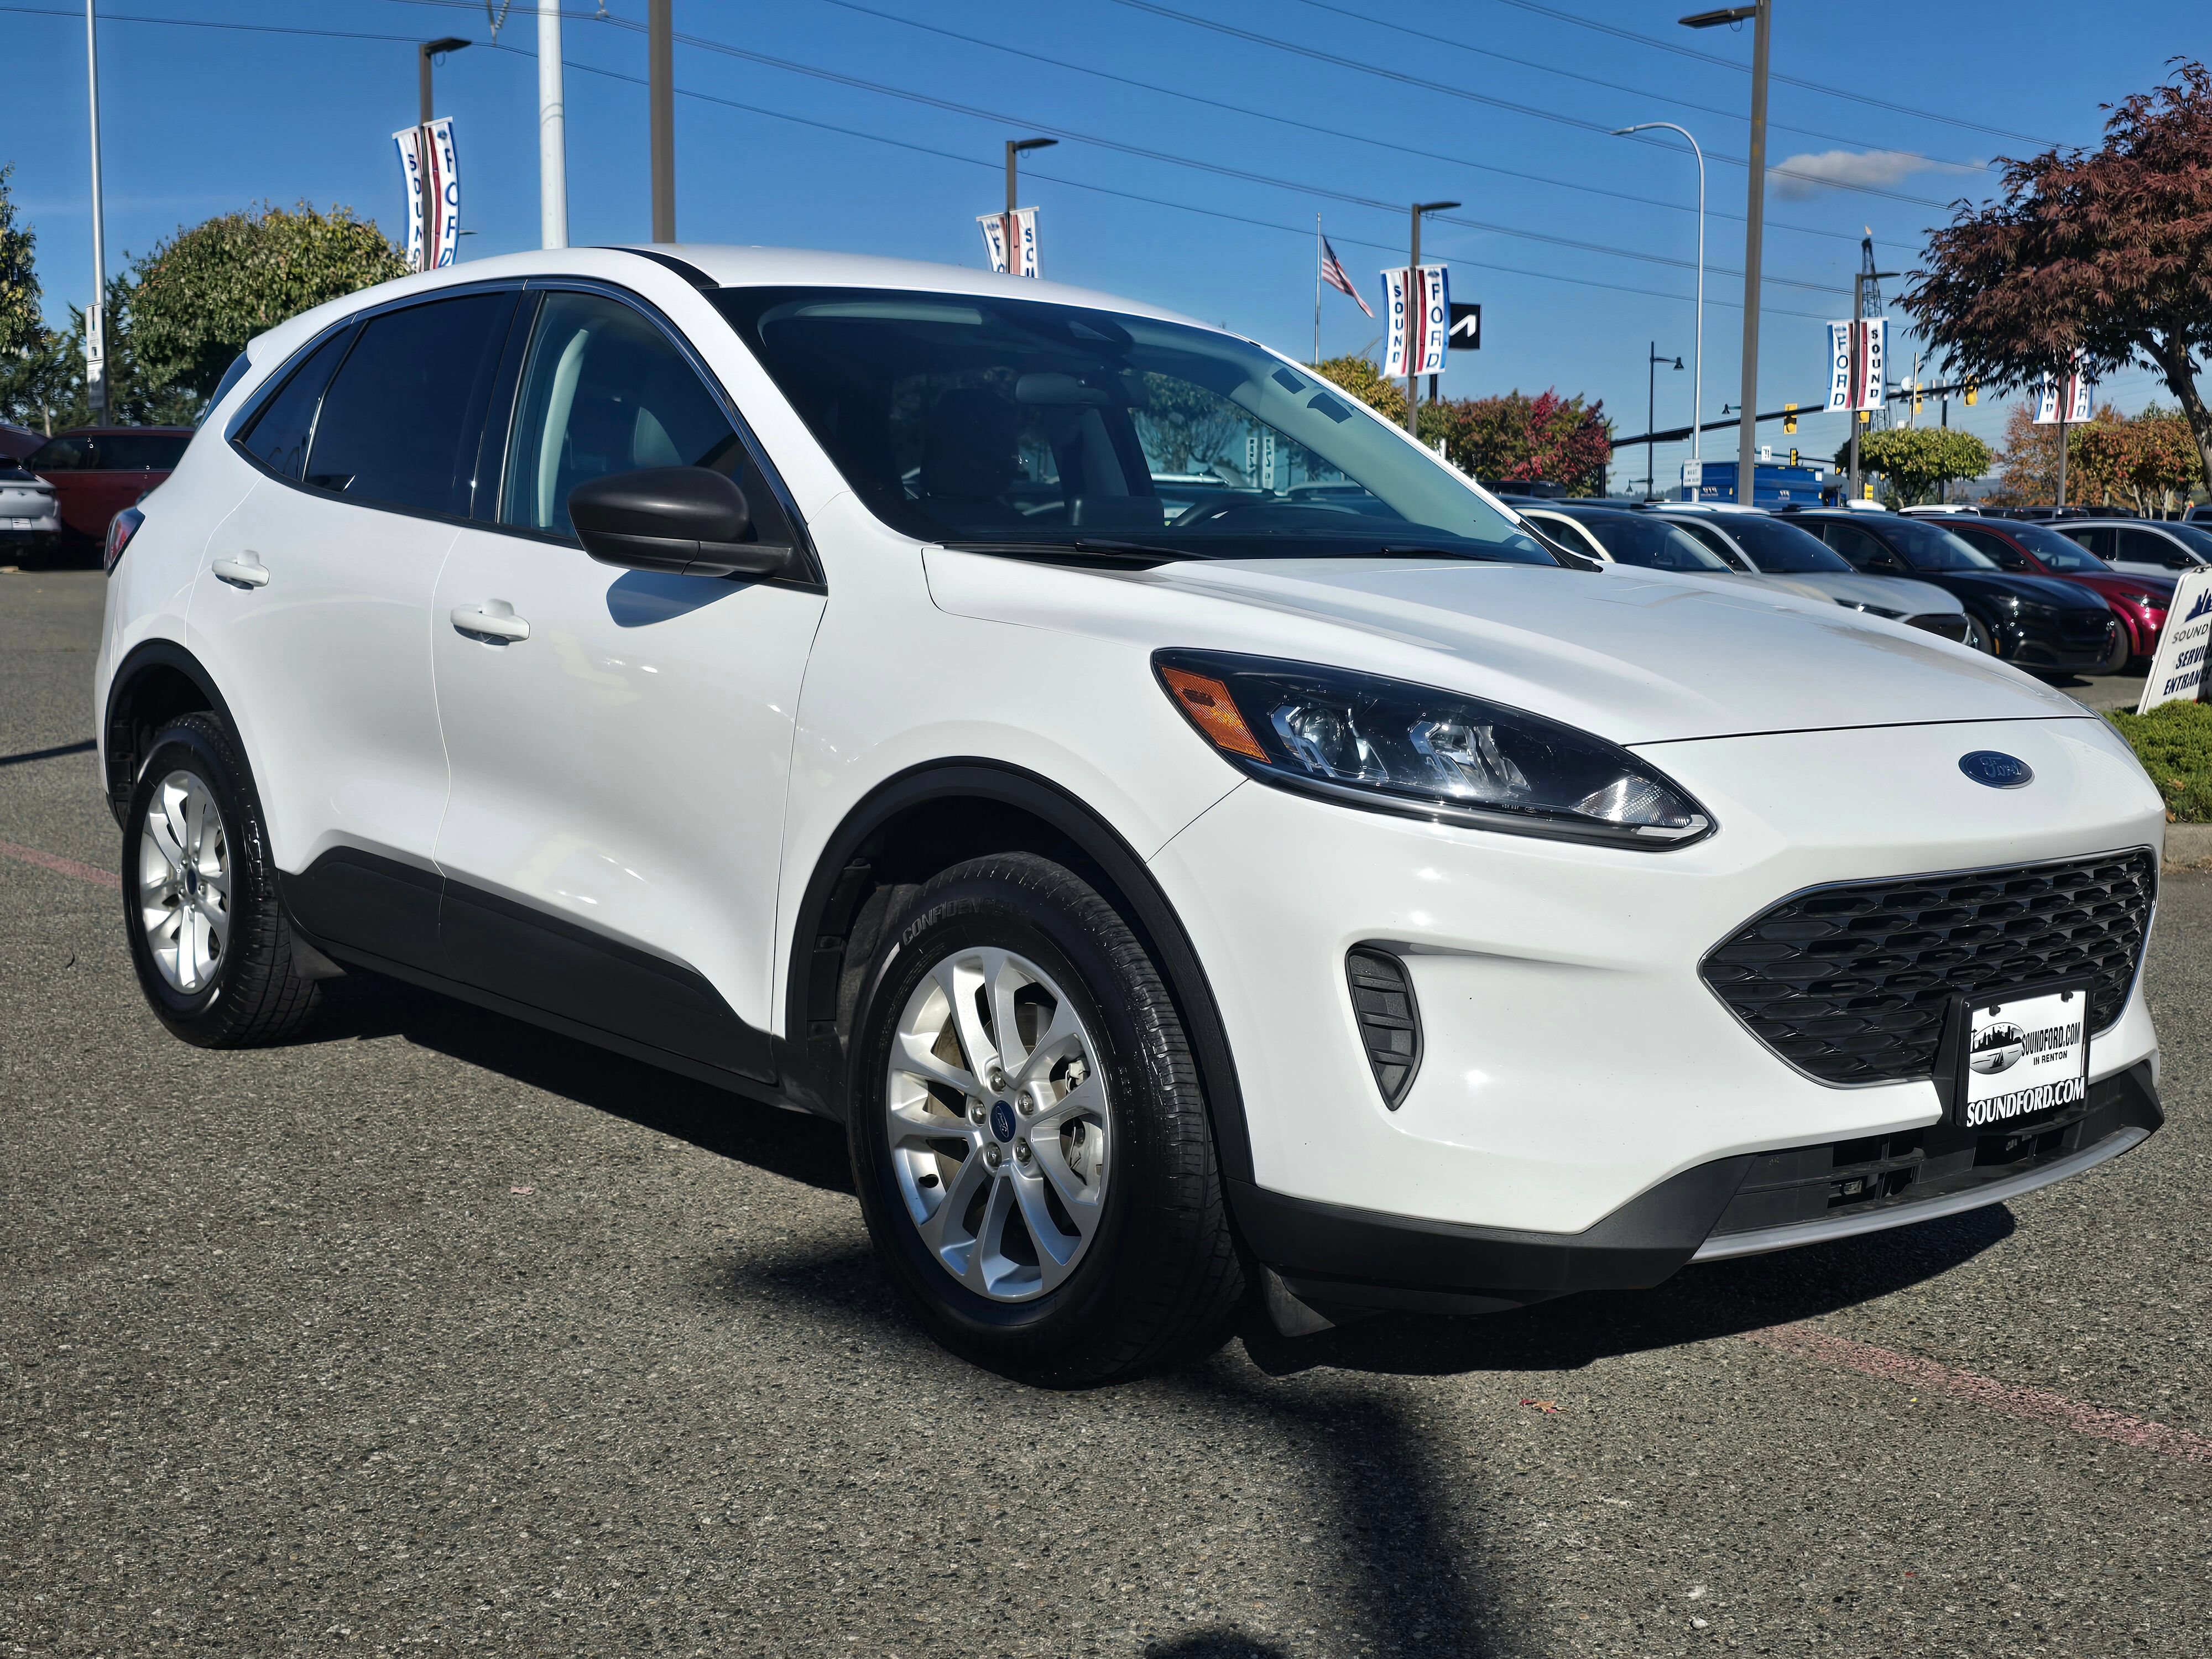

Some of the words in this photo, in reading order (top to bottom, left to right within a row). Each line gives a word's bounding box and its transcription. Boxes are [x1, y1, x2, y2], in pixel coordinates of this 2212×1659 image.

[1393, 285, 1404, 363] SOUND
[1426, 283, 1443, 368] FORD
[1833, 336, 1849, 406] FORD
[1870, 329, 1881, 398] SOUND
[2172, 623, 2209, 644] SOUND
[2021, 1021, 2080, 1057] SOUNDFORD.COM
[2033, 1057, 2039, 1066] IN
[2042, 1050, 2068, 1063] RENTON
[1966, 1077, 2085, 1128] SOUNDFORD.COM
